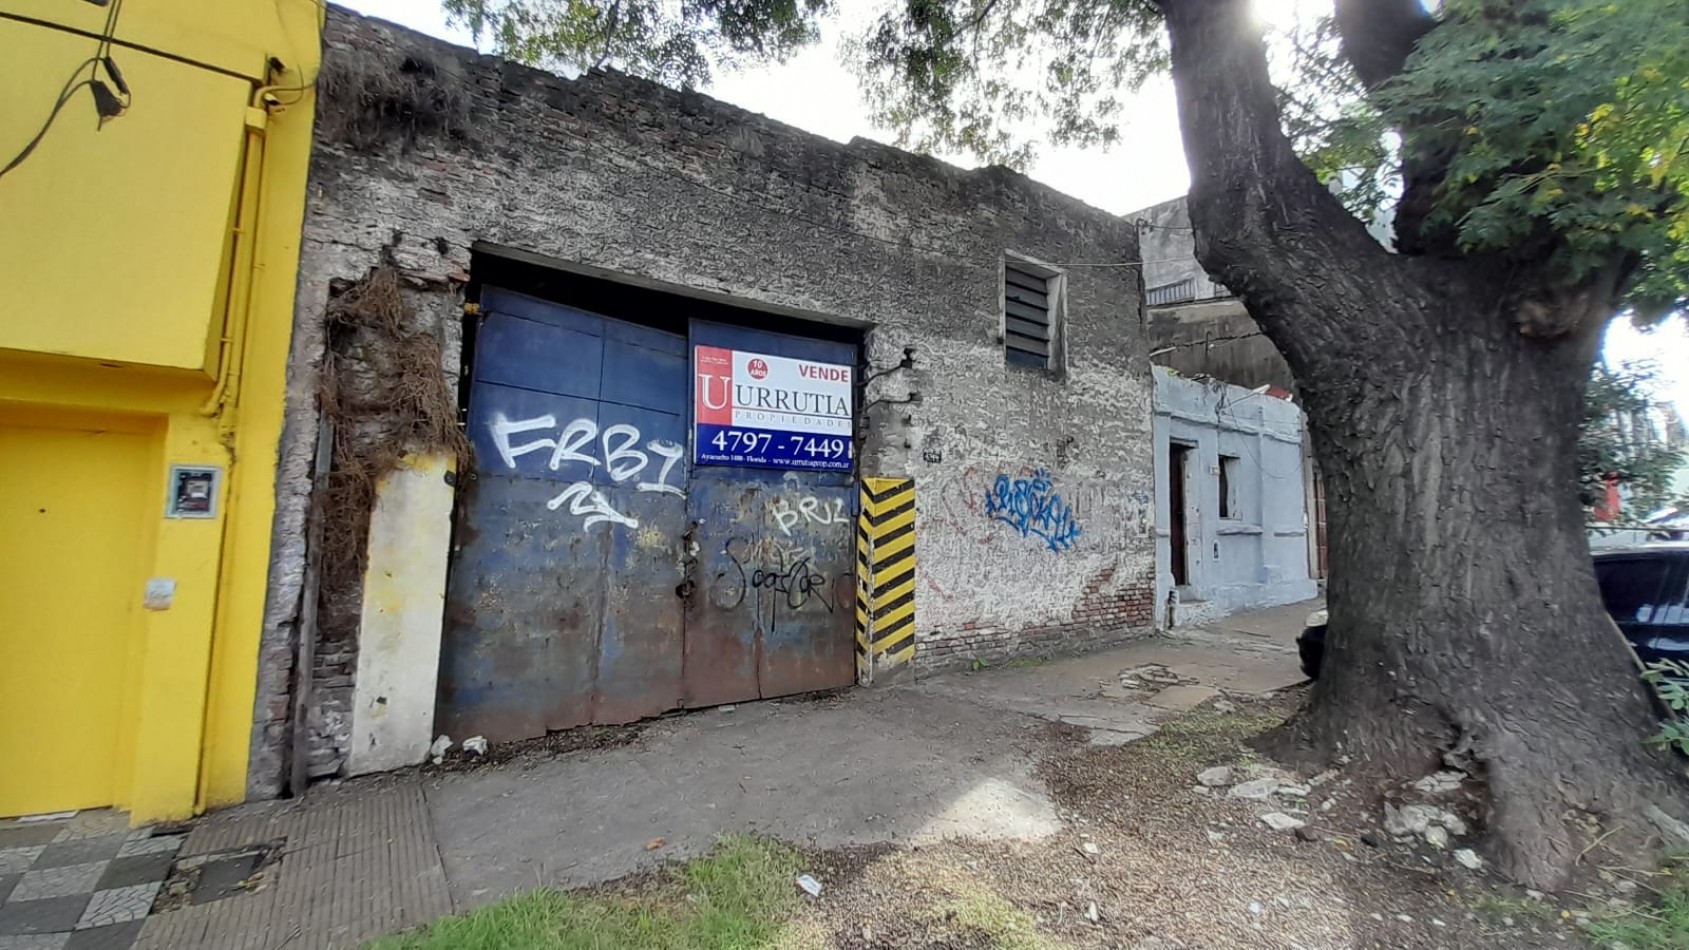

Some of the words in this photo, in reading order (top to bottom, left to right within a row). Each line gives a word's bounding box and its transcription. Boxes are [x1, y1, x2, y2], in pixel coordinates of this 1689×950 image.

[753, 360, 763, 369] 10
[799, 364, 849, 383] VENDE
[699, 373, 731, 410] U
[735, 384, 850, 416] URRUTIA
[711, 430, 772, 454] 4797
[790, 436, 844, 459] 7449
